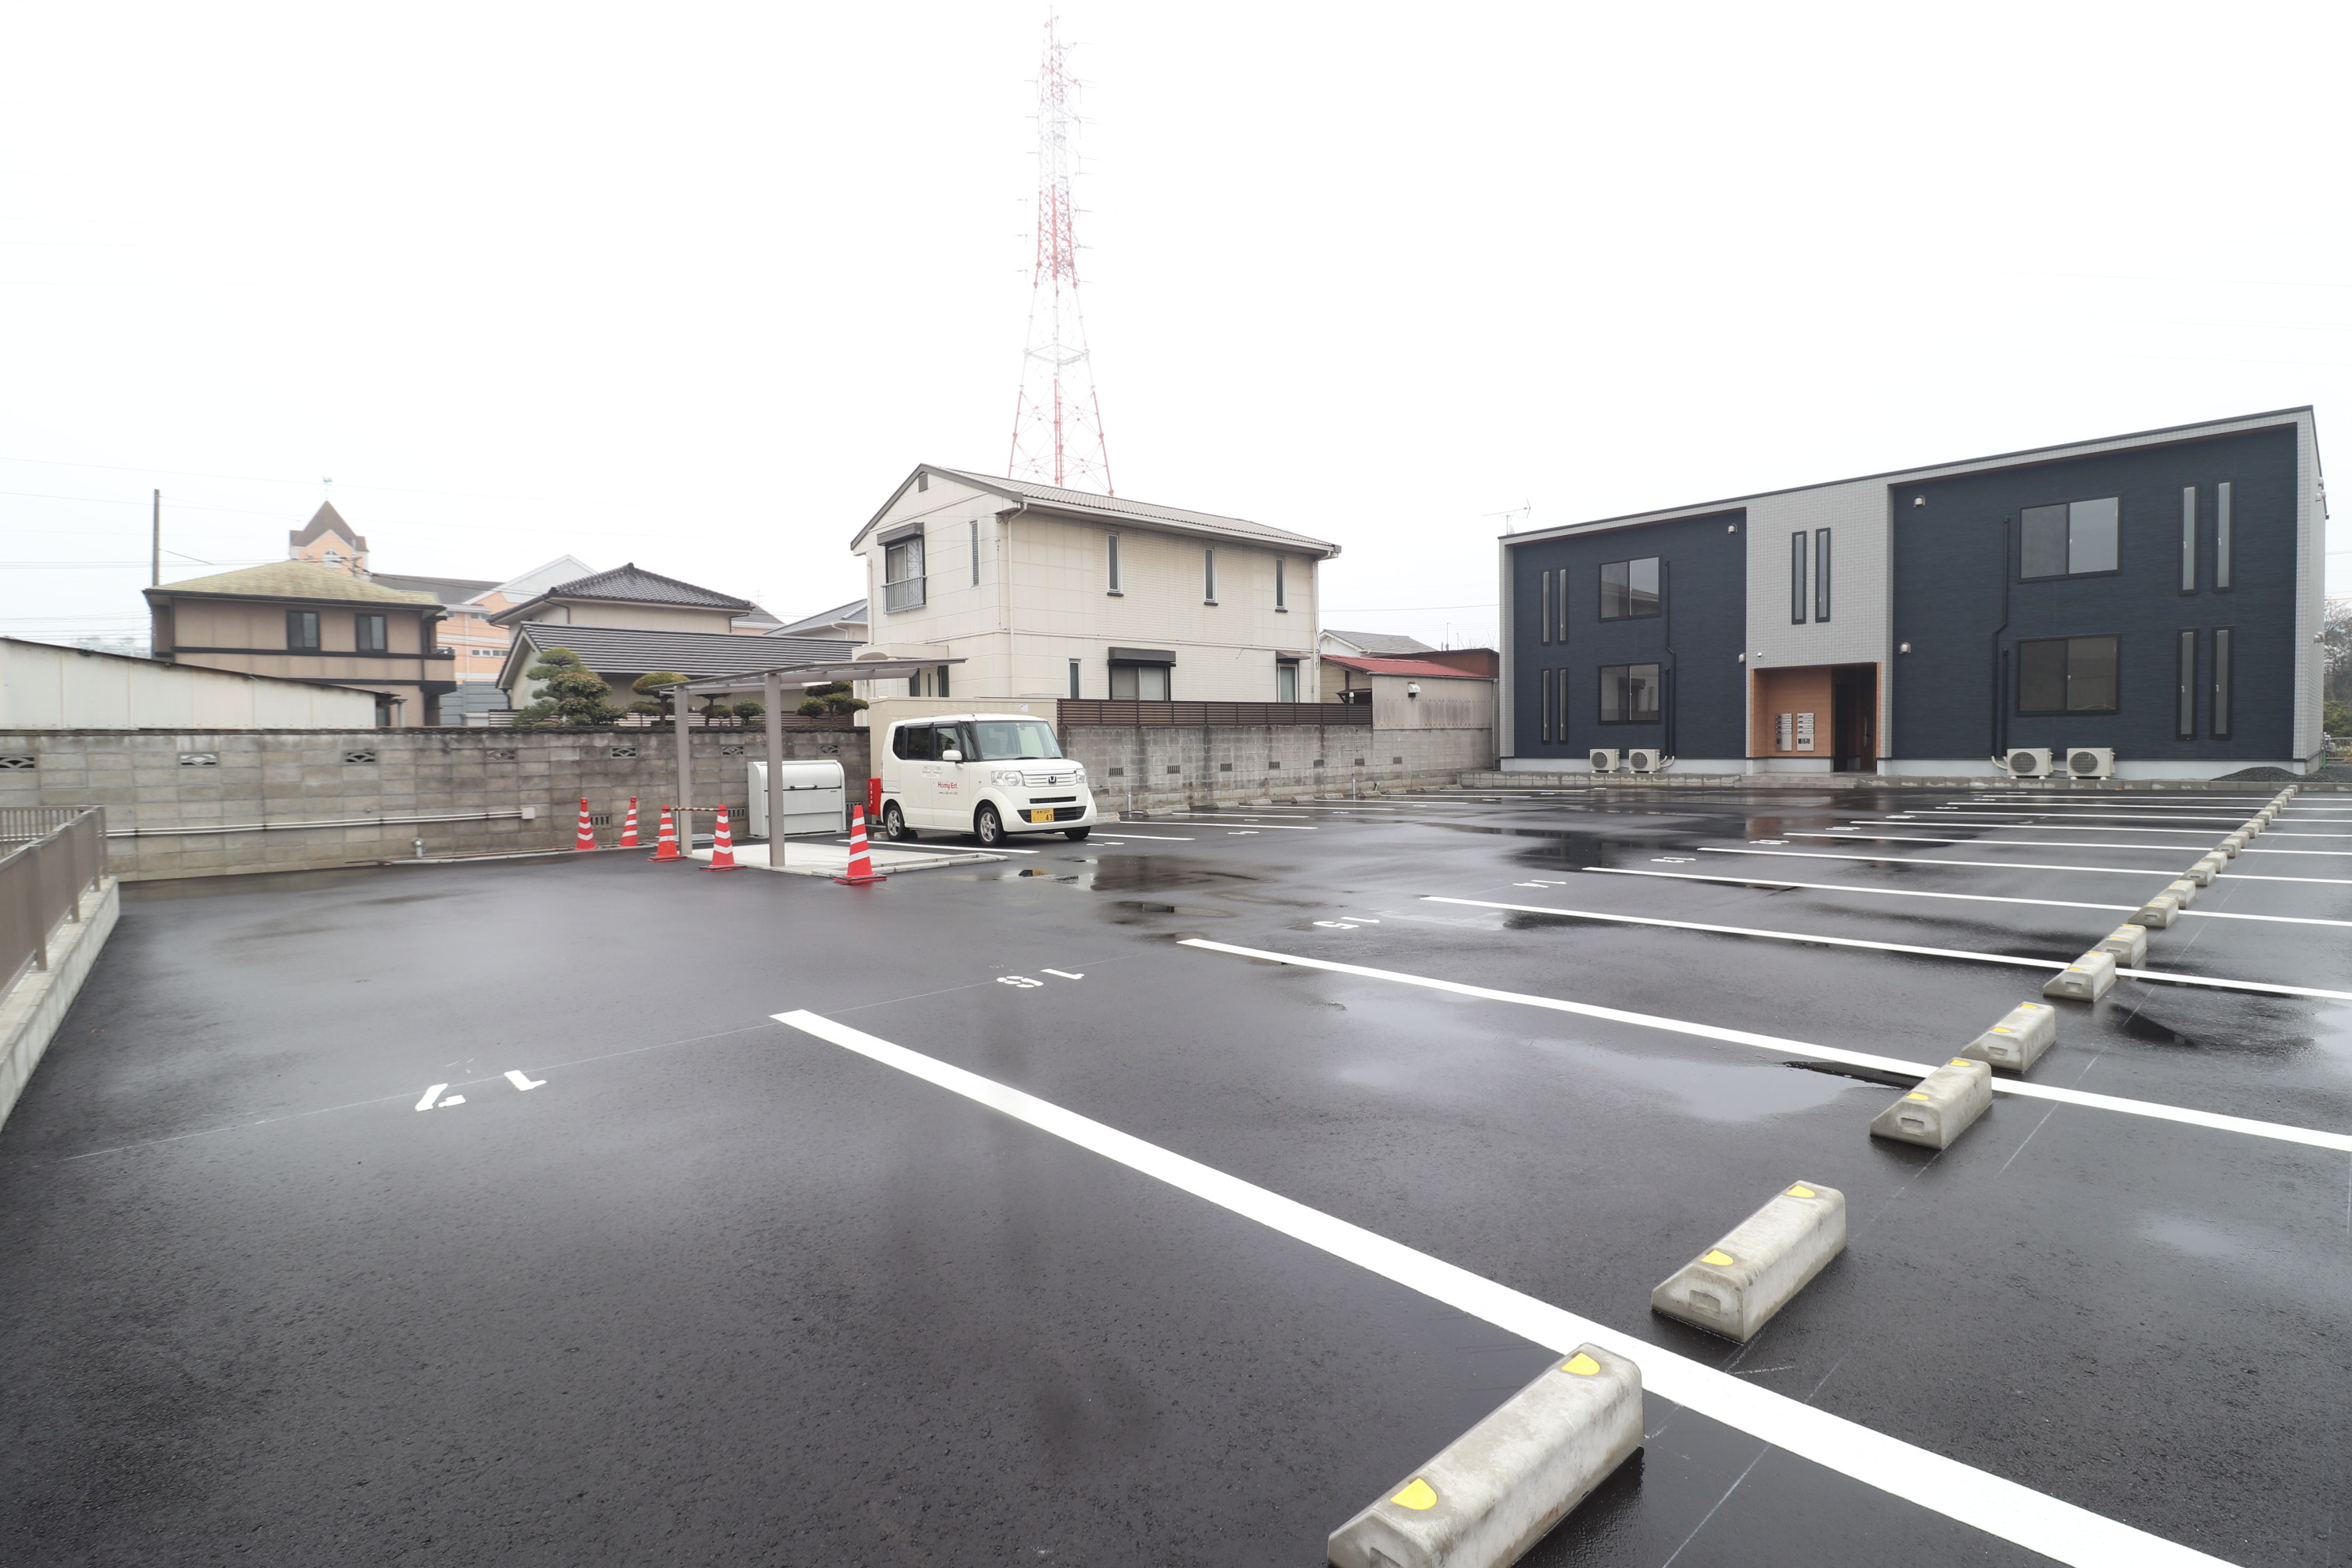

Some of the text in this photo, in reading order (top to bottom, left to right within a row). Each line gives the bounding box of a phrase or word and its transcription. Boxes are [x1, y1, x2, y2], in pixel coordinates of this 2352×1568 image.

[1312, 916, 1381, 929] 15
[997, 968, 1085, 988] 16
[414, 1069, 547, 1112] 17
